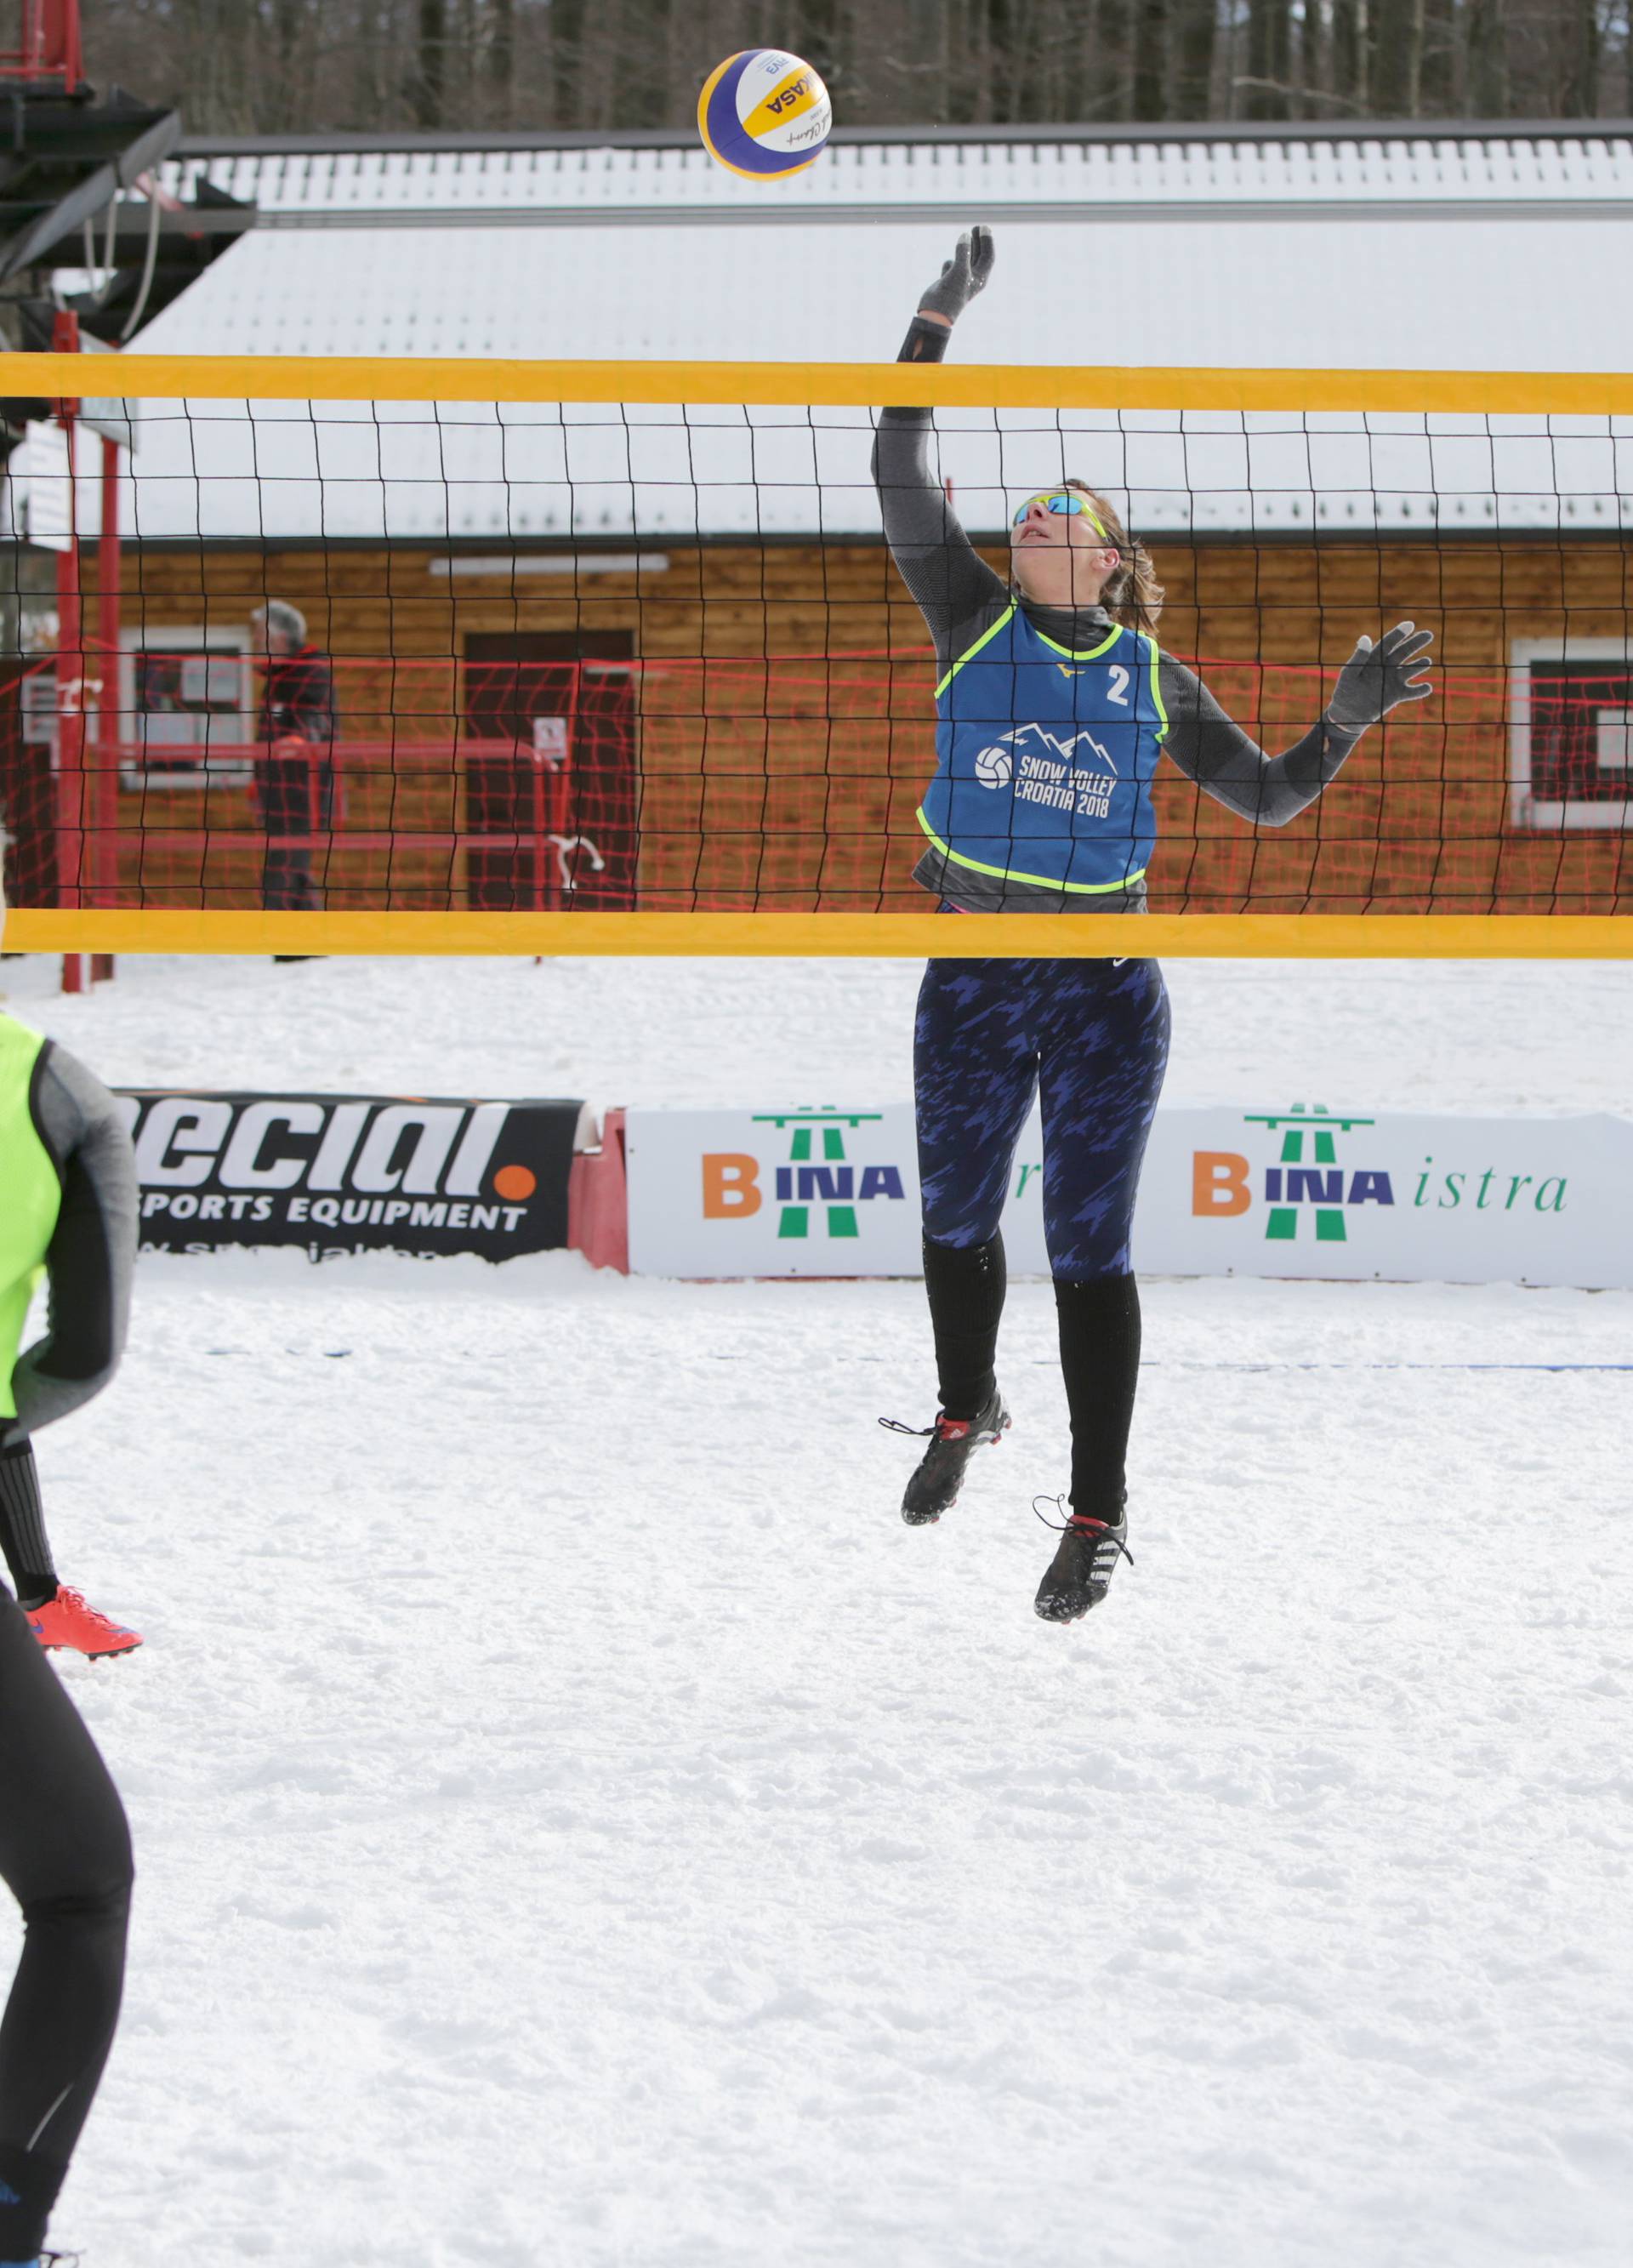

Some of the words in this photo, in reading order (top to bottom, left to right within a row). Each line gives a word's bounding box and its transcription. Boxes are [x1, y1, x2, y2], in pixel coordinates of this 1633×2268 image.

[1107, 664, 1129, 706] 2
[1019, 755, 1067, 780] SNOW
[1069, 765, 1117, 797] VOLLEY
[1014, 778, 1075, 811] CROATIA
[1076, 794, 1110, 818] 2018
[1413, 1156, 1568, 1212] istra
[139, 1193, 274, 1222] PORTS
[286, 1198, 527, 1232] EQUIPMENT
